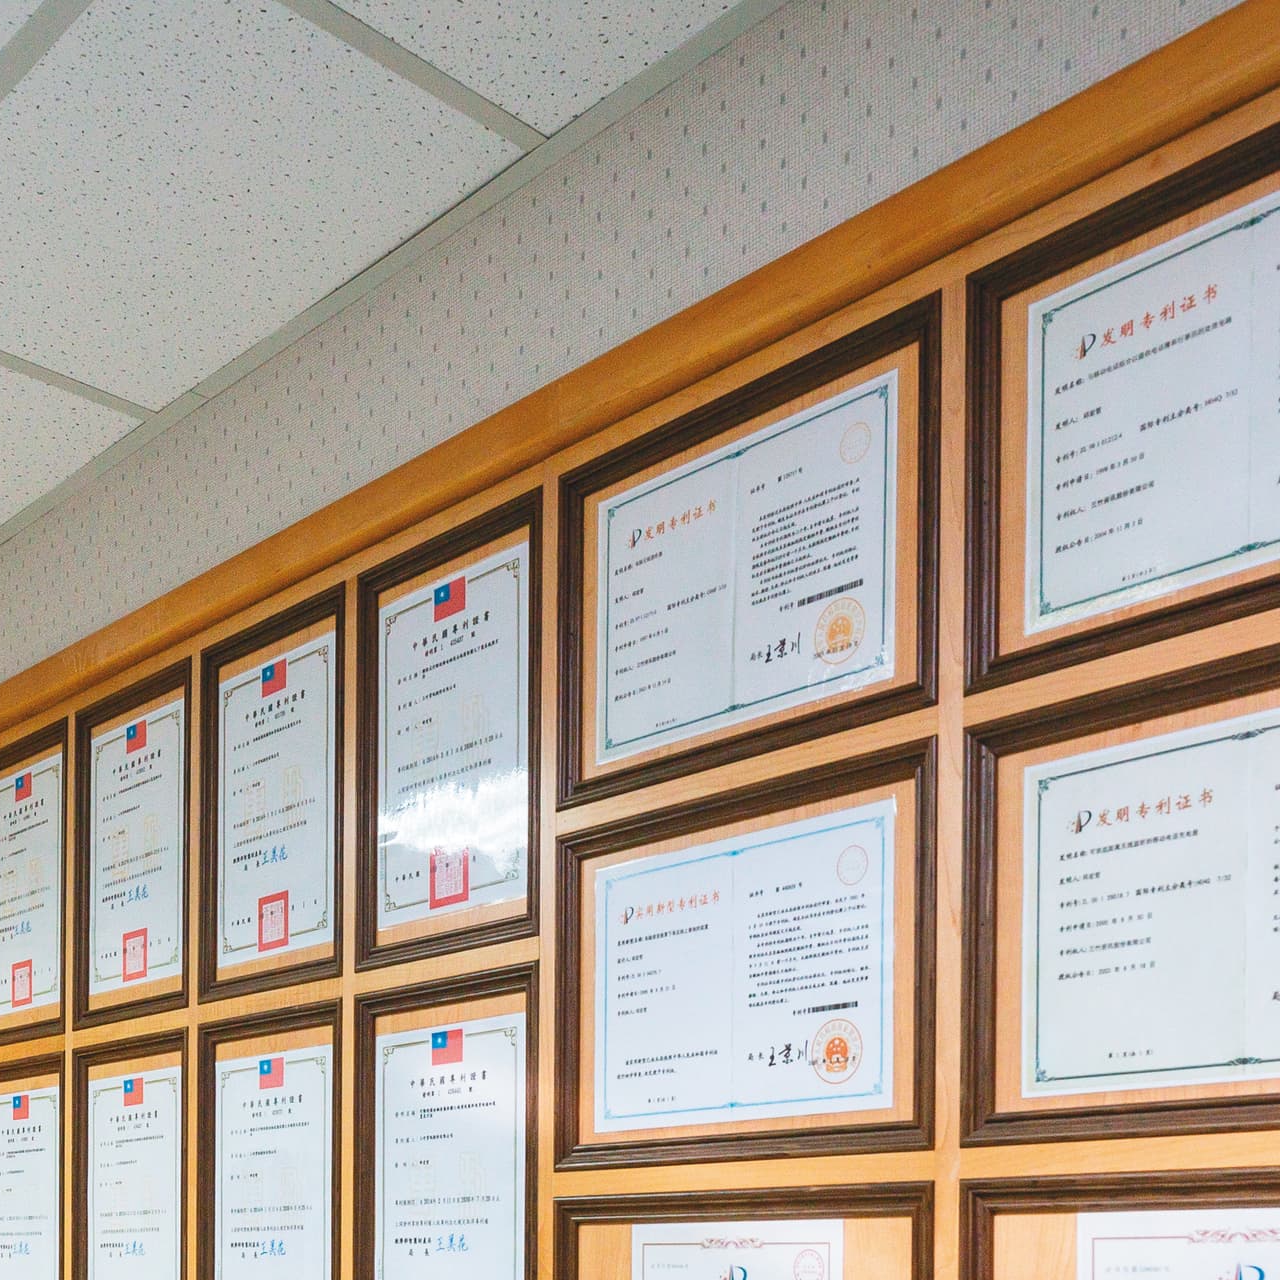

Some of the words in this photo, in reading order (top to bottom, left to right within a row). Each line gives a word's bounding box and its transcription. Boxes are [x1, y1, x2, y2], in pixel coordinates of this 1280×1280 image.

[1101, 284, 1218, 347] 发明专利证书
[643, 499, 717, 541] 发明专利证书
[1097, 787, 1213, 827] 发明专利证书
